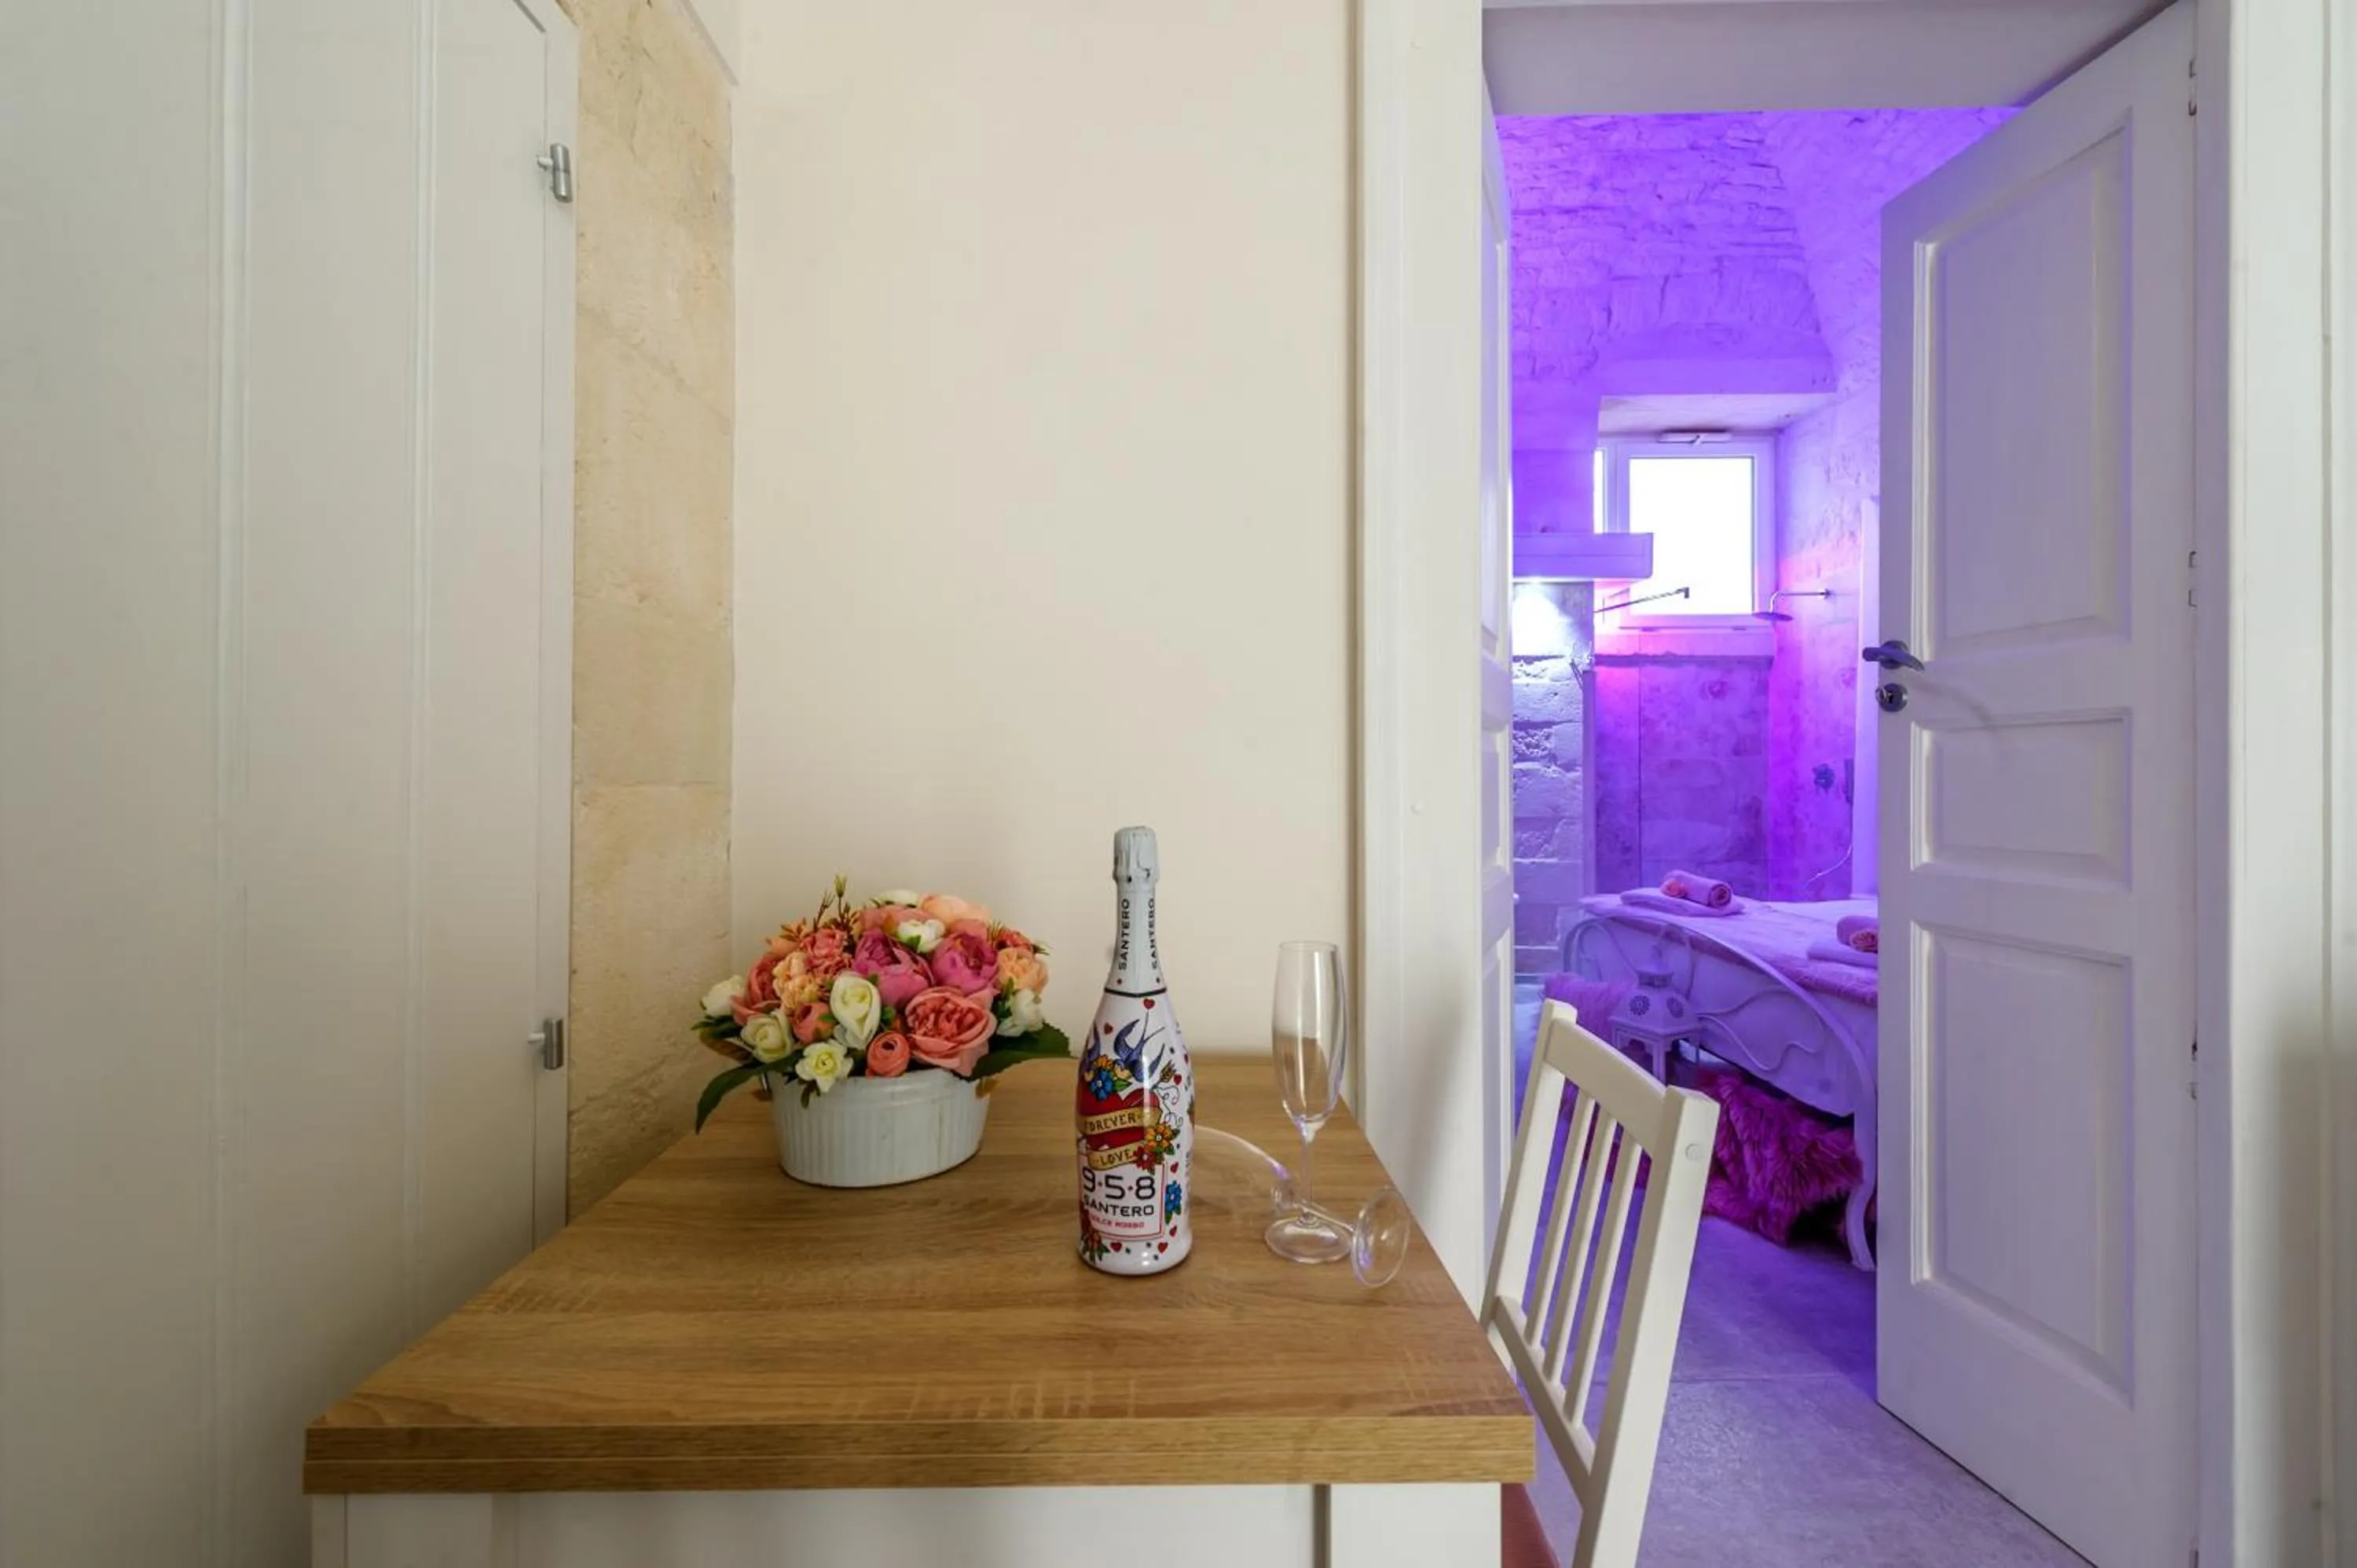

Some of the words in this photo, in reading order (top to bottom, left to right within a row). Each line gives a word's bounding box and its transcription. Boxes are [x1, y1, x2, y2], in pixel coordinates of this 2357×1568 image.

[1118, 898, 1131, 971] SANTERO
[1101, 1149, 1132, 1166] LOVE
[1083, 1195, 1155, 1217] SANTERO
